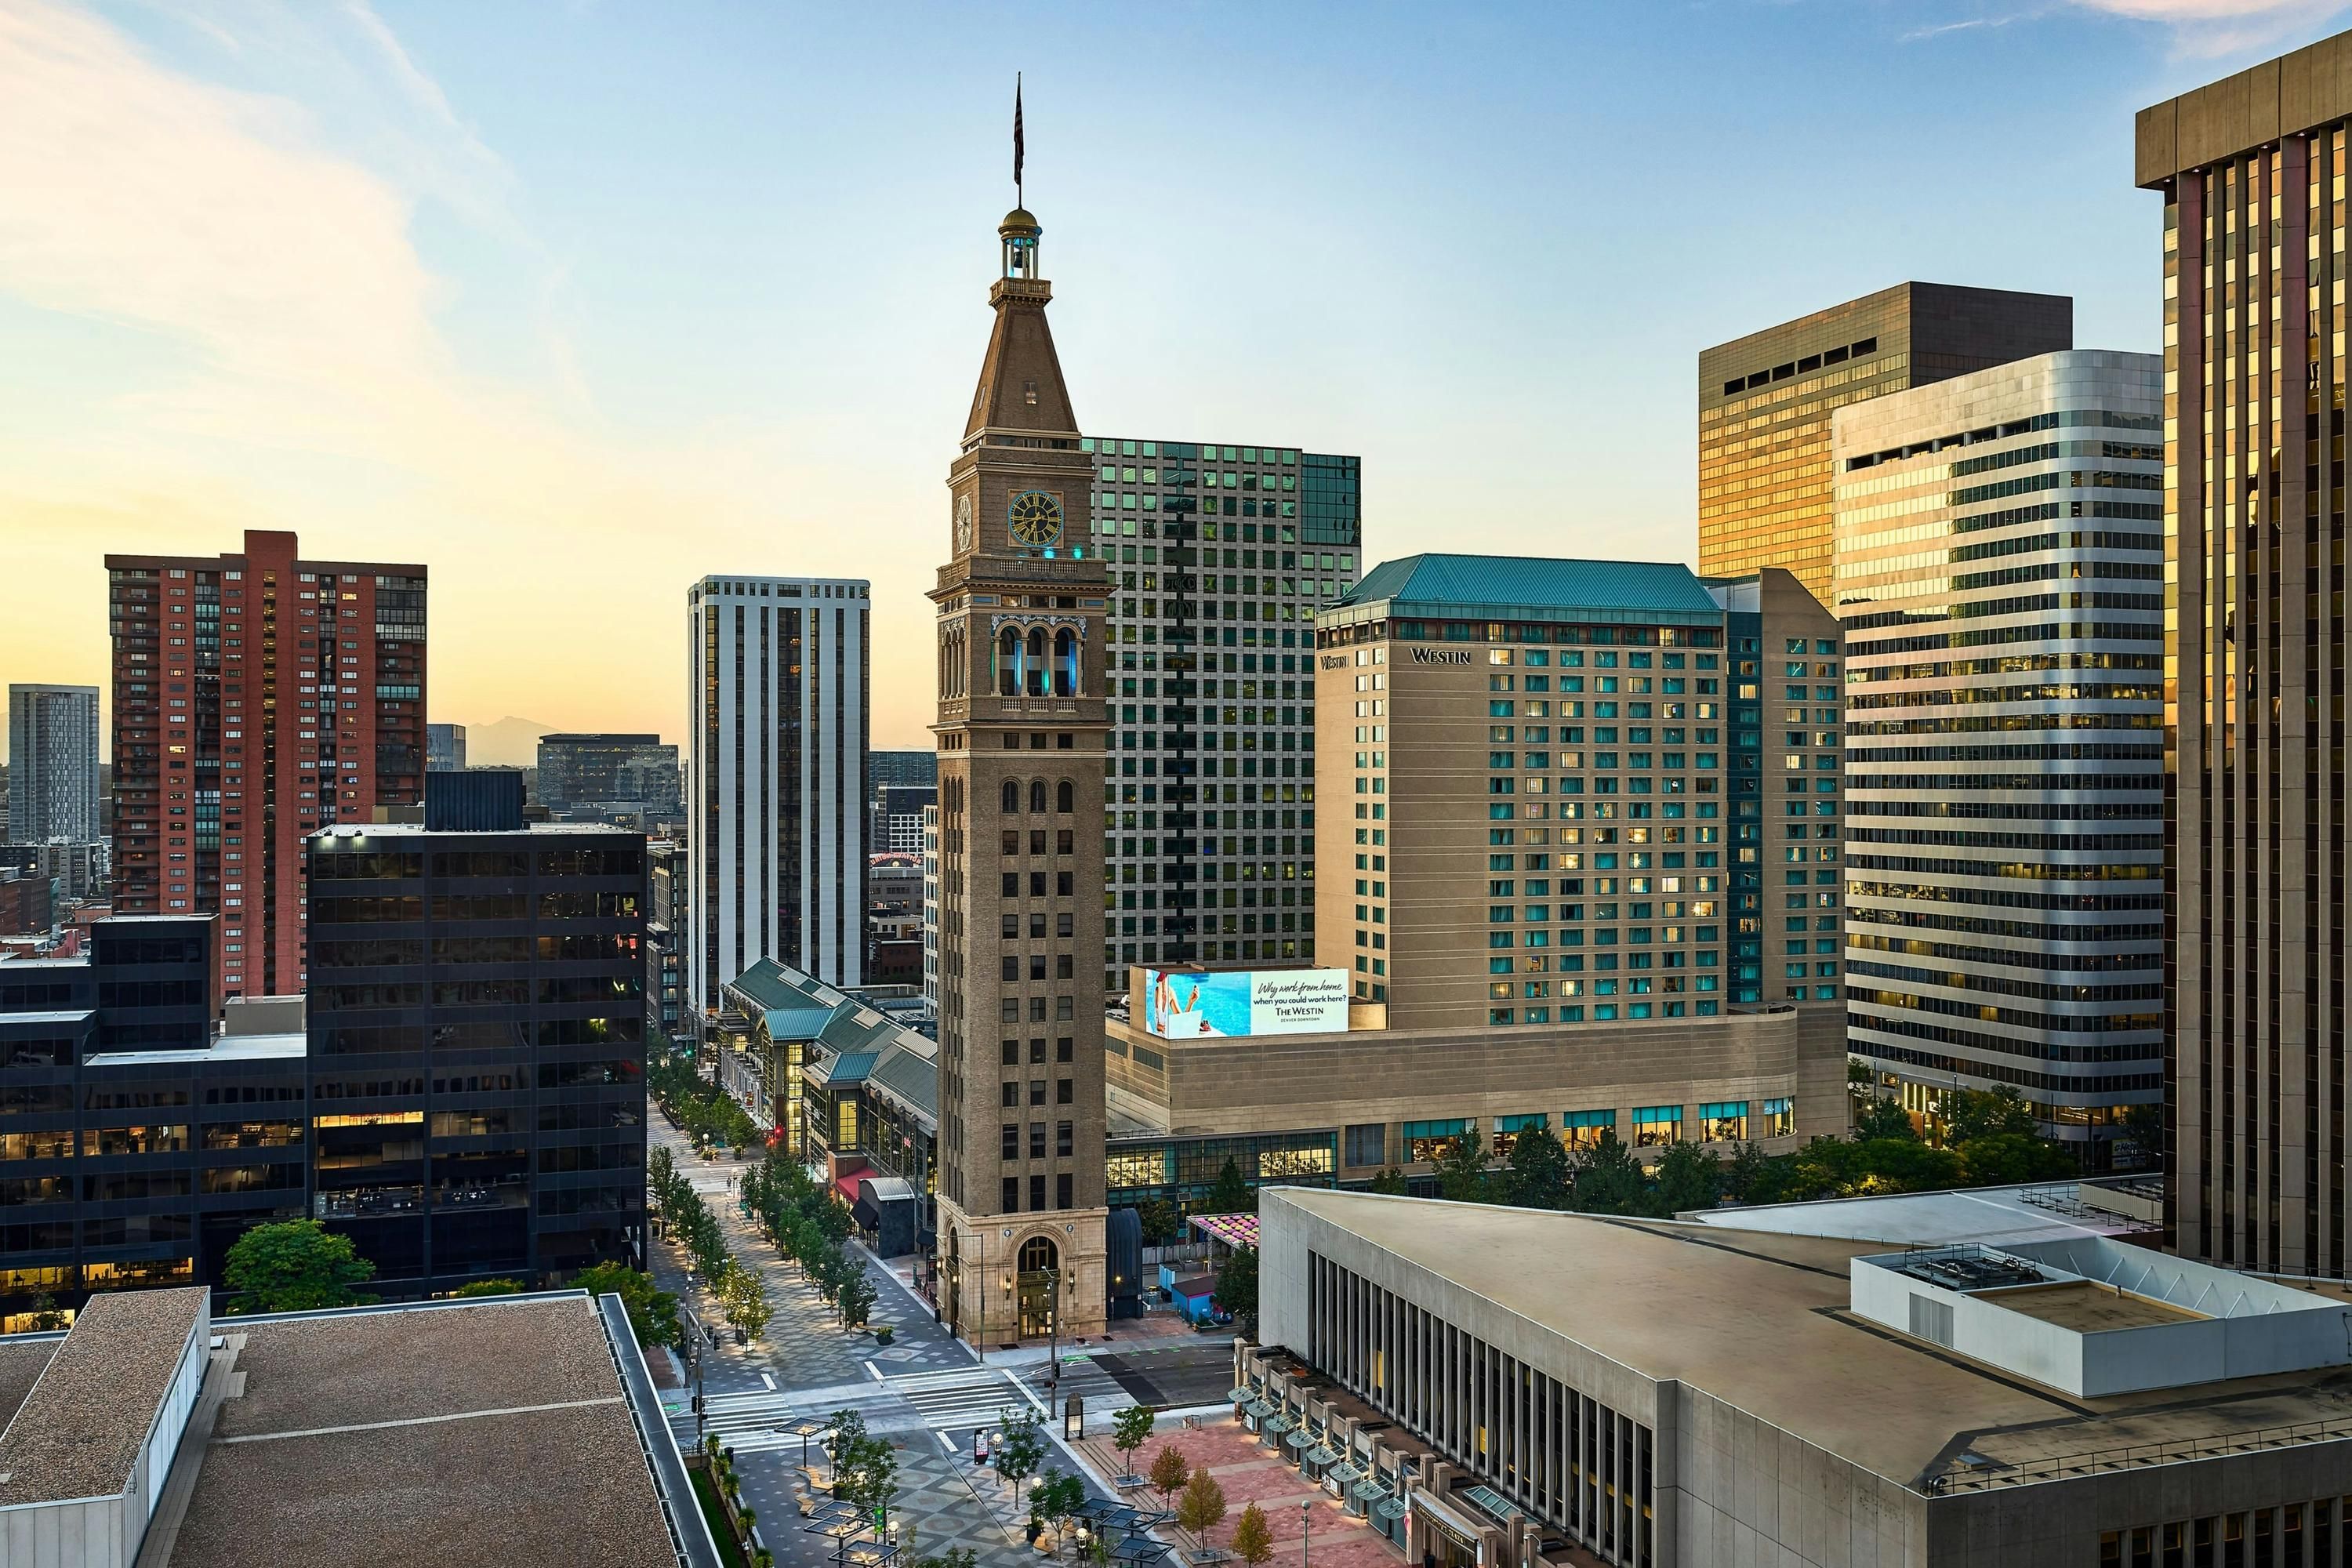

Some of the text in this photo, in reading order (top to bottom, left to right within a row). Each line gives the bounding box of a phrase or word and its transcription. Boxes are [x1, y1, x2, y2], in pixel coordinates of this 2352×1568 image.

[1320, 655, 1348, 670] WESTIN
[1410, 647, 1471, 665] WESTIN
[870, 853, 891, 865] UNION
[1258, 979, 1343, 999] Why work from home
[1276, 1007, 1291, 1016] THE
